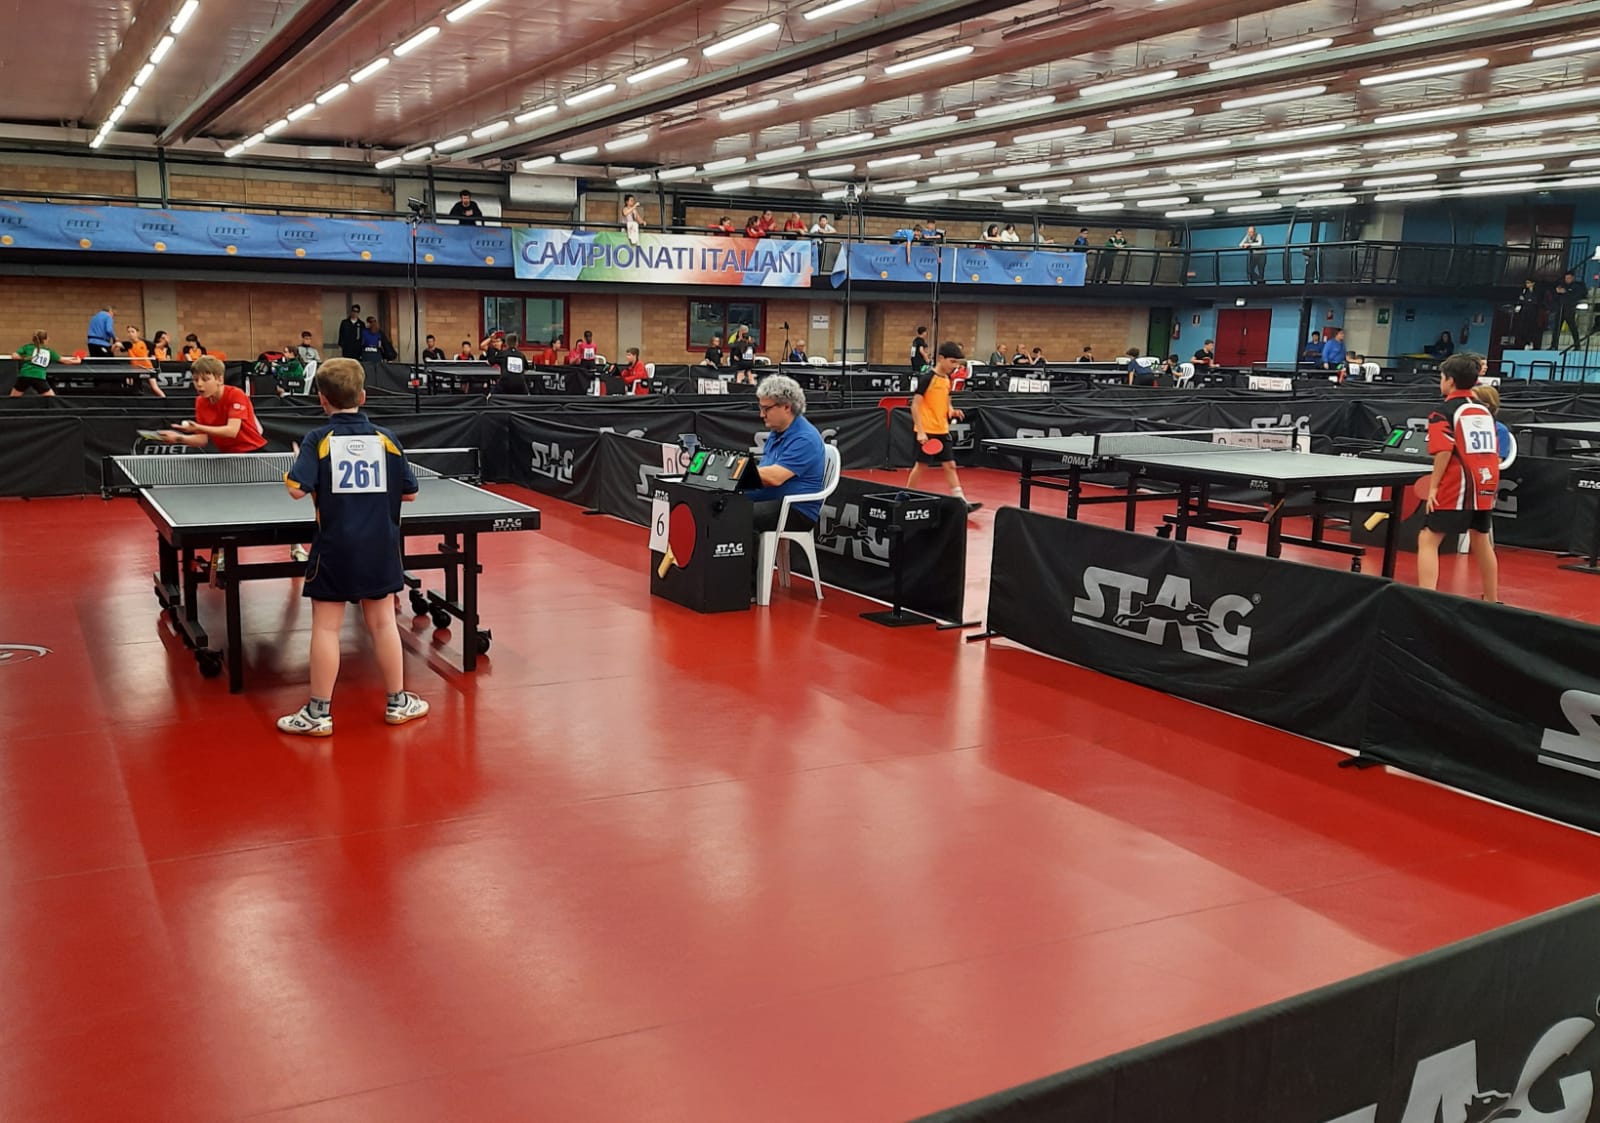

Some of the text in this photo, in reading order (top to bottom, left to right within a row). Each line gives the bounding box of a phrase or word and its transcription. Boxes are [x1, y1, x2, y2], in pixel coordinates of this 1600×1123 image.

[521, 240, 802, 274] CAMPIONATI ITALIANI
[144, 445, 188, 455] FITET
[1061, 454, 1086, 466] ROMA
[531, 441, 575, 485] STAG
[690, 451, 707, 474] 5
[338, 460, 381, 489] 261
[493, 517, 522, 528] STAG
[656, 512, 665, 537] 6
[904, 508, 930, 521] STAG
[714, 542, 744, 555] STAG
[1071, 565, 1256, 667] STAG
